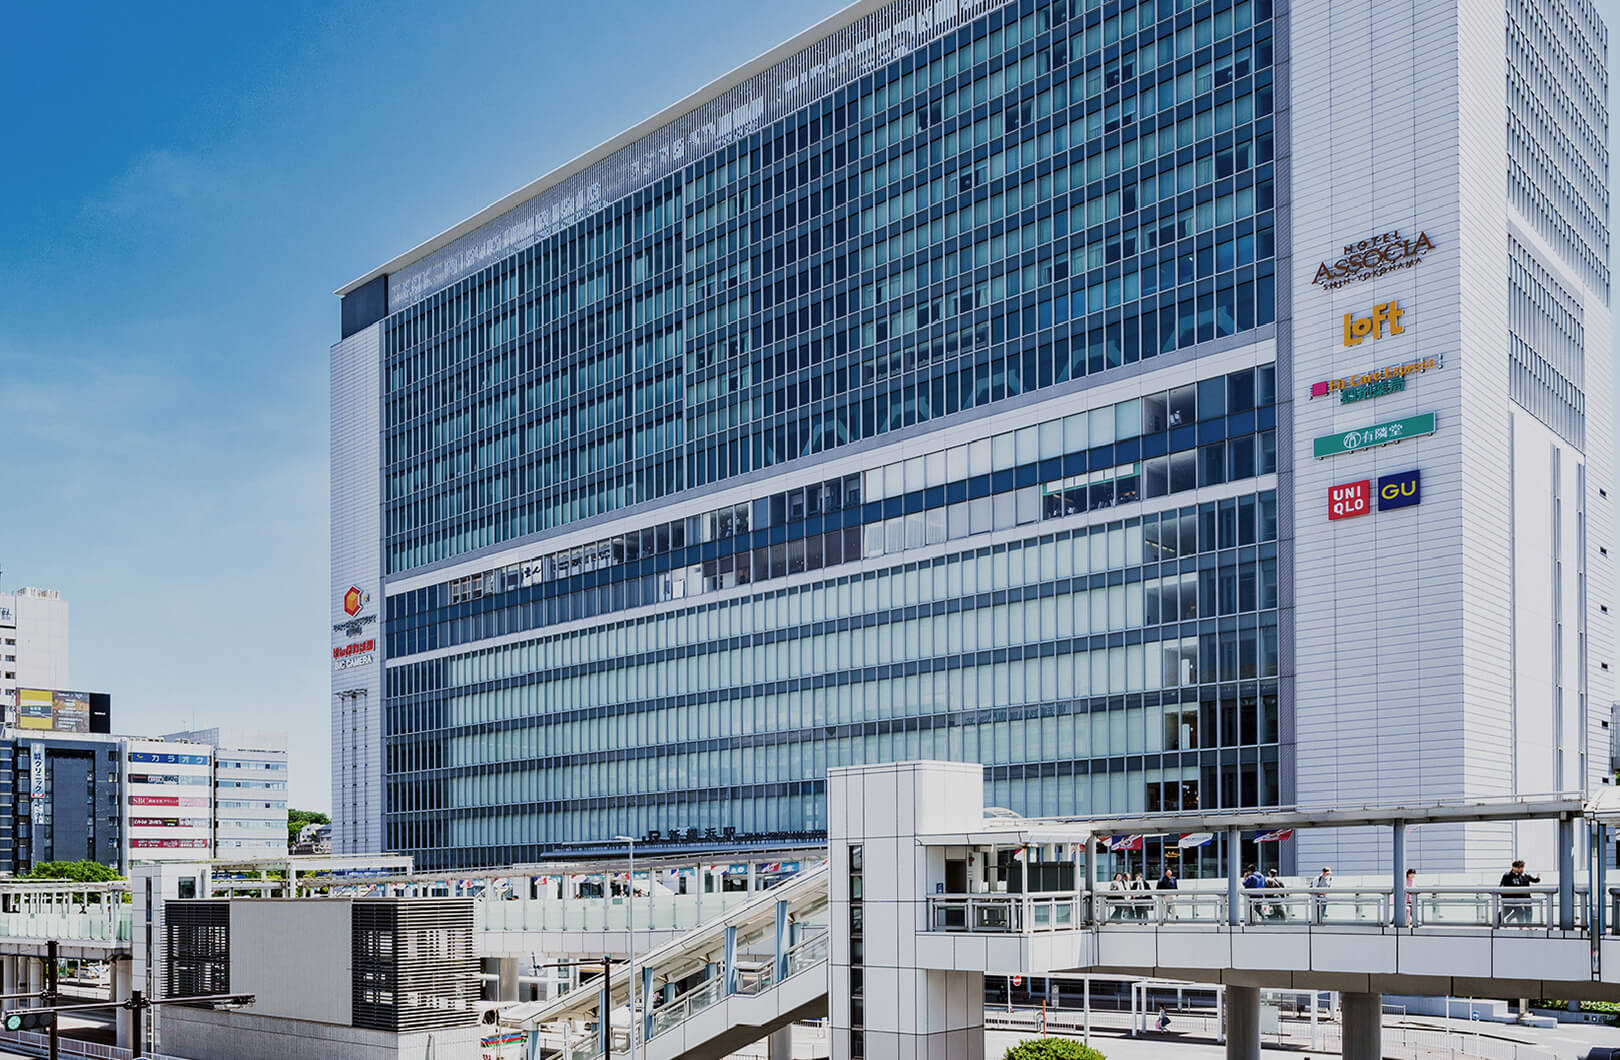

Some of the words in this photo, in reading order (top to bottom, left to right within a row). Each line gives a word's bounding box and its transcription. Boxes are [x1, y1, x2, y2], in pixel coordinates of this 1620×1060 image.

[1343, 230, 1401, 255] HOTEL
[1311, 231, 1436, 285] ASSOCIA
[1329, 379, 1346, 393] Fit
[1349, 369, 1384, 387] Care
[1384, 357, 1437, 379] Express
[1333, 485, 1362, 501] UNI
[1381, 480, 1417, 500] GU
[1333, 498, 1364, 514] QLO
